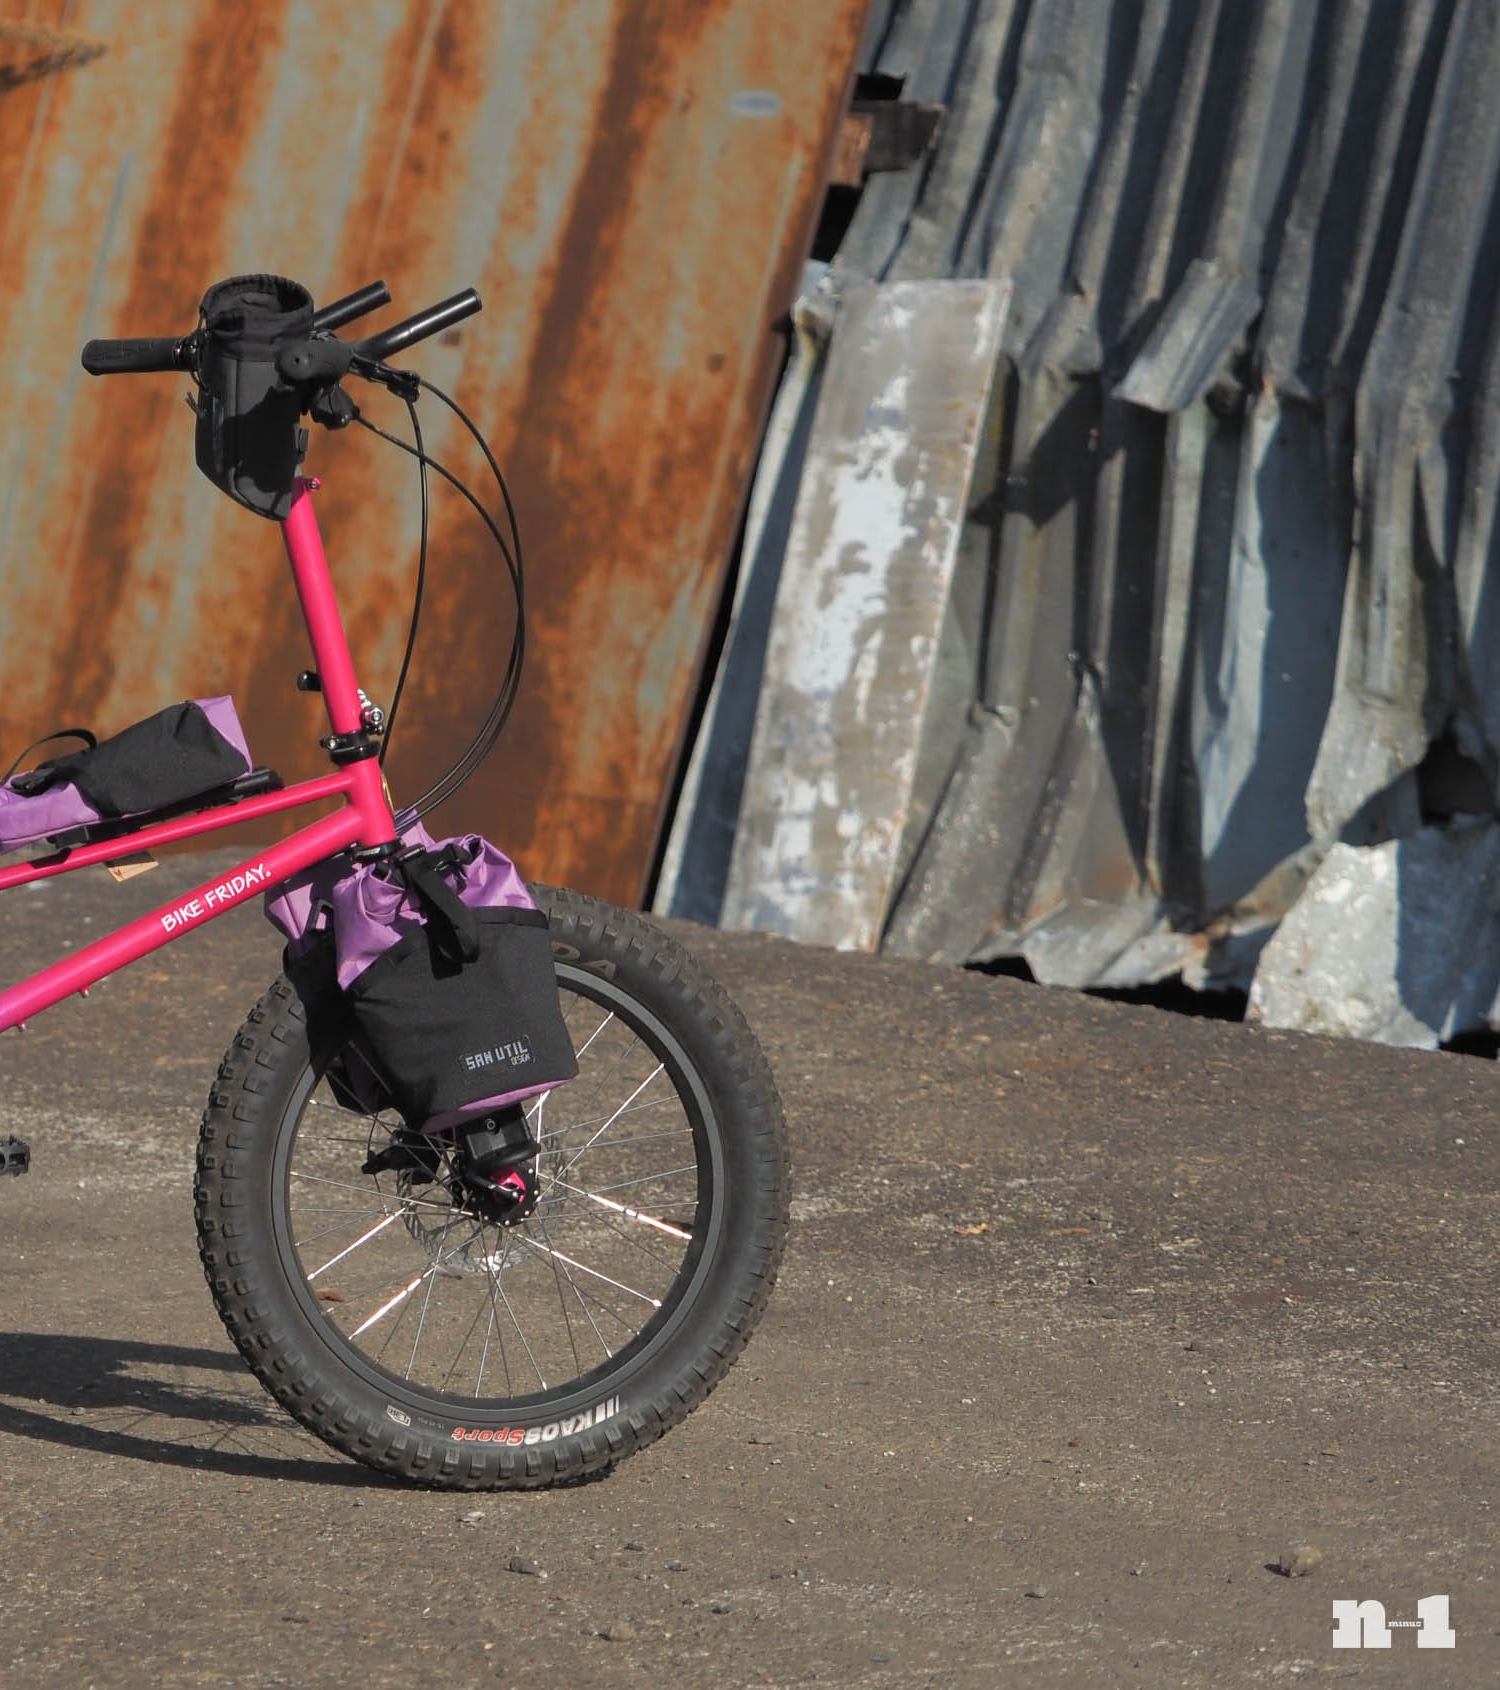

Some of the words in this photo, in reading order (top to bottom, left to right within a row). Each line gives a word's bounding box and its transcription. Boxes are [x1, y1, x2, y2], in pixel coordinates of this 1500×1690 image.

[161, 899, 204, 932] BIKE
[465, 1050, 494, 1071] SAN
[495, 1041, 528, 1061] UTIL
